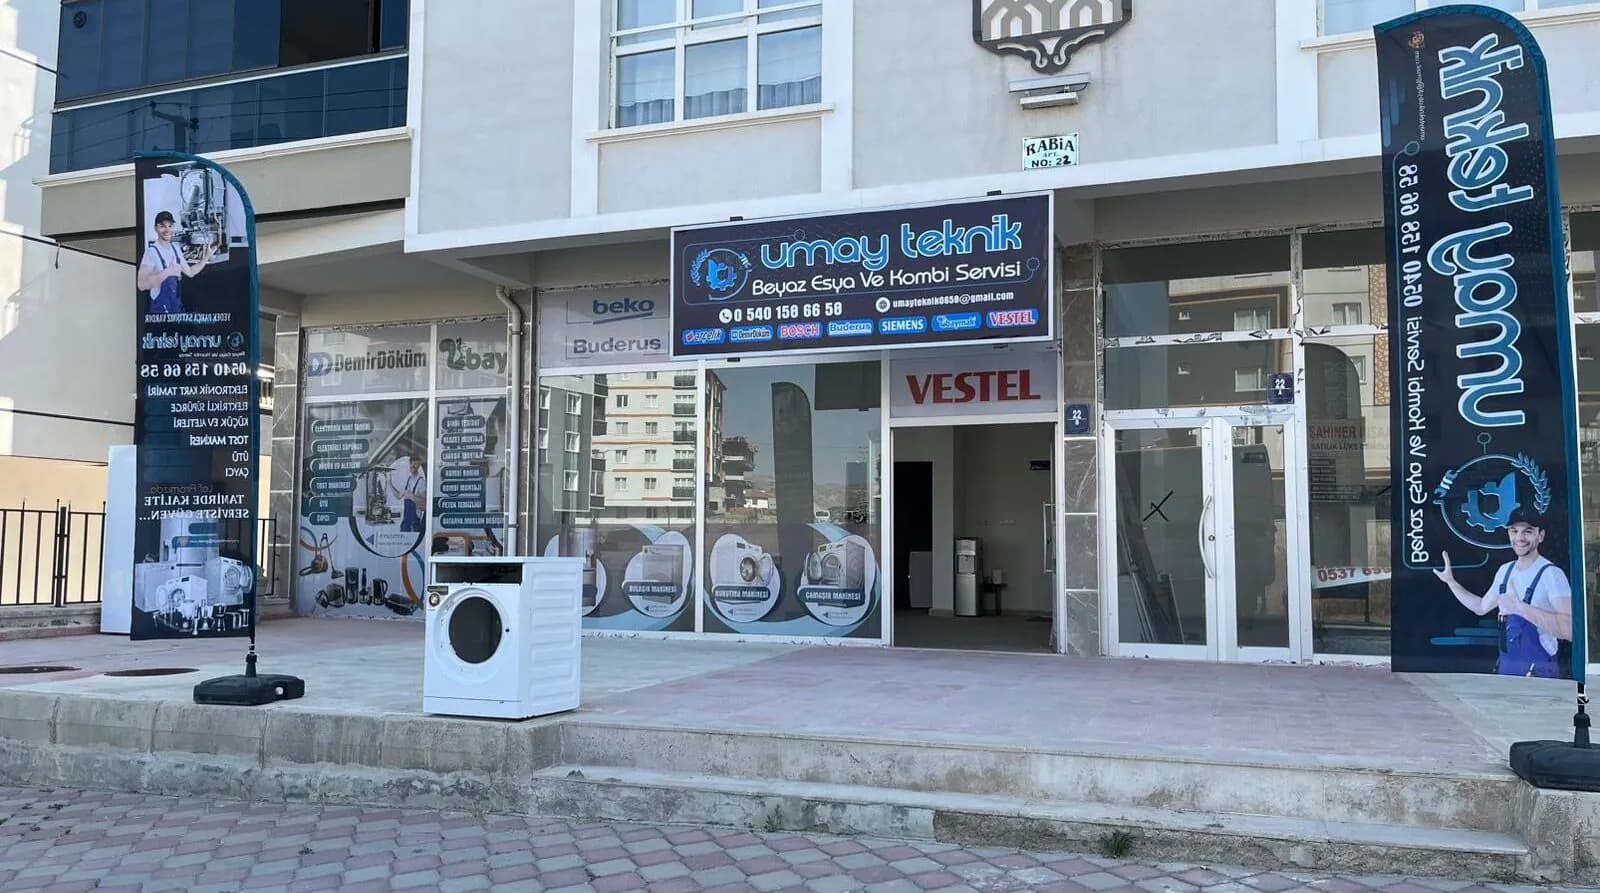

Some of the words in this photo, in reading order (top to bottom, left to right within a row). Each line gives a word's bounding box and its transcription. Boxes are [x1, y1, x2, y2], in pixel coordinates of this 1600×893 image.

[1056, 155, 1071, 165] 22
[760, 233, 890, 271] umay
[900, 213, 1022, 259] teknik
[752, 279, 807, 298] Beyaz
[859, 271, 885, 289] Ve
[889, 266, 950, 287] Kombi
[955, 260, 1022, 280] Servisi
[593, 298, 655, 315] beko
[733, 308, 742, 322] 0
[746, 306, 772, 321] 540
[775, 304, 799, 319] 158
[803, 303, 820, 318] 66
[825, 301, 843, 316] 58
[882, 318, 924, 332] SIEMENS
[989, 310, 1035, 326] VESTEL
[780, 325, 819, 337] BOSCH
[829, 321, 872, 333] Buderus
[573, 337, 661, 354] Buderus
[334, 349, 427, 373] DemirDöküm
[906, 369, 1041, 405] VESTEL
[1275, 379, 1285, 389] 22
[1073, 410, 1081, 419] 22
